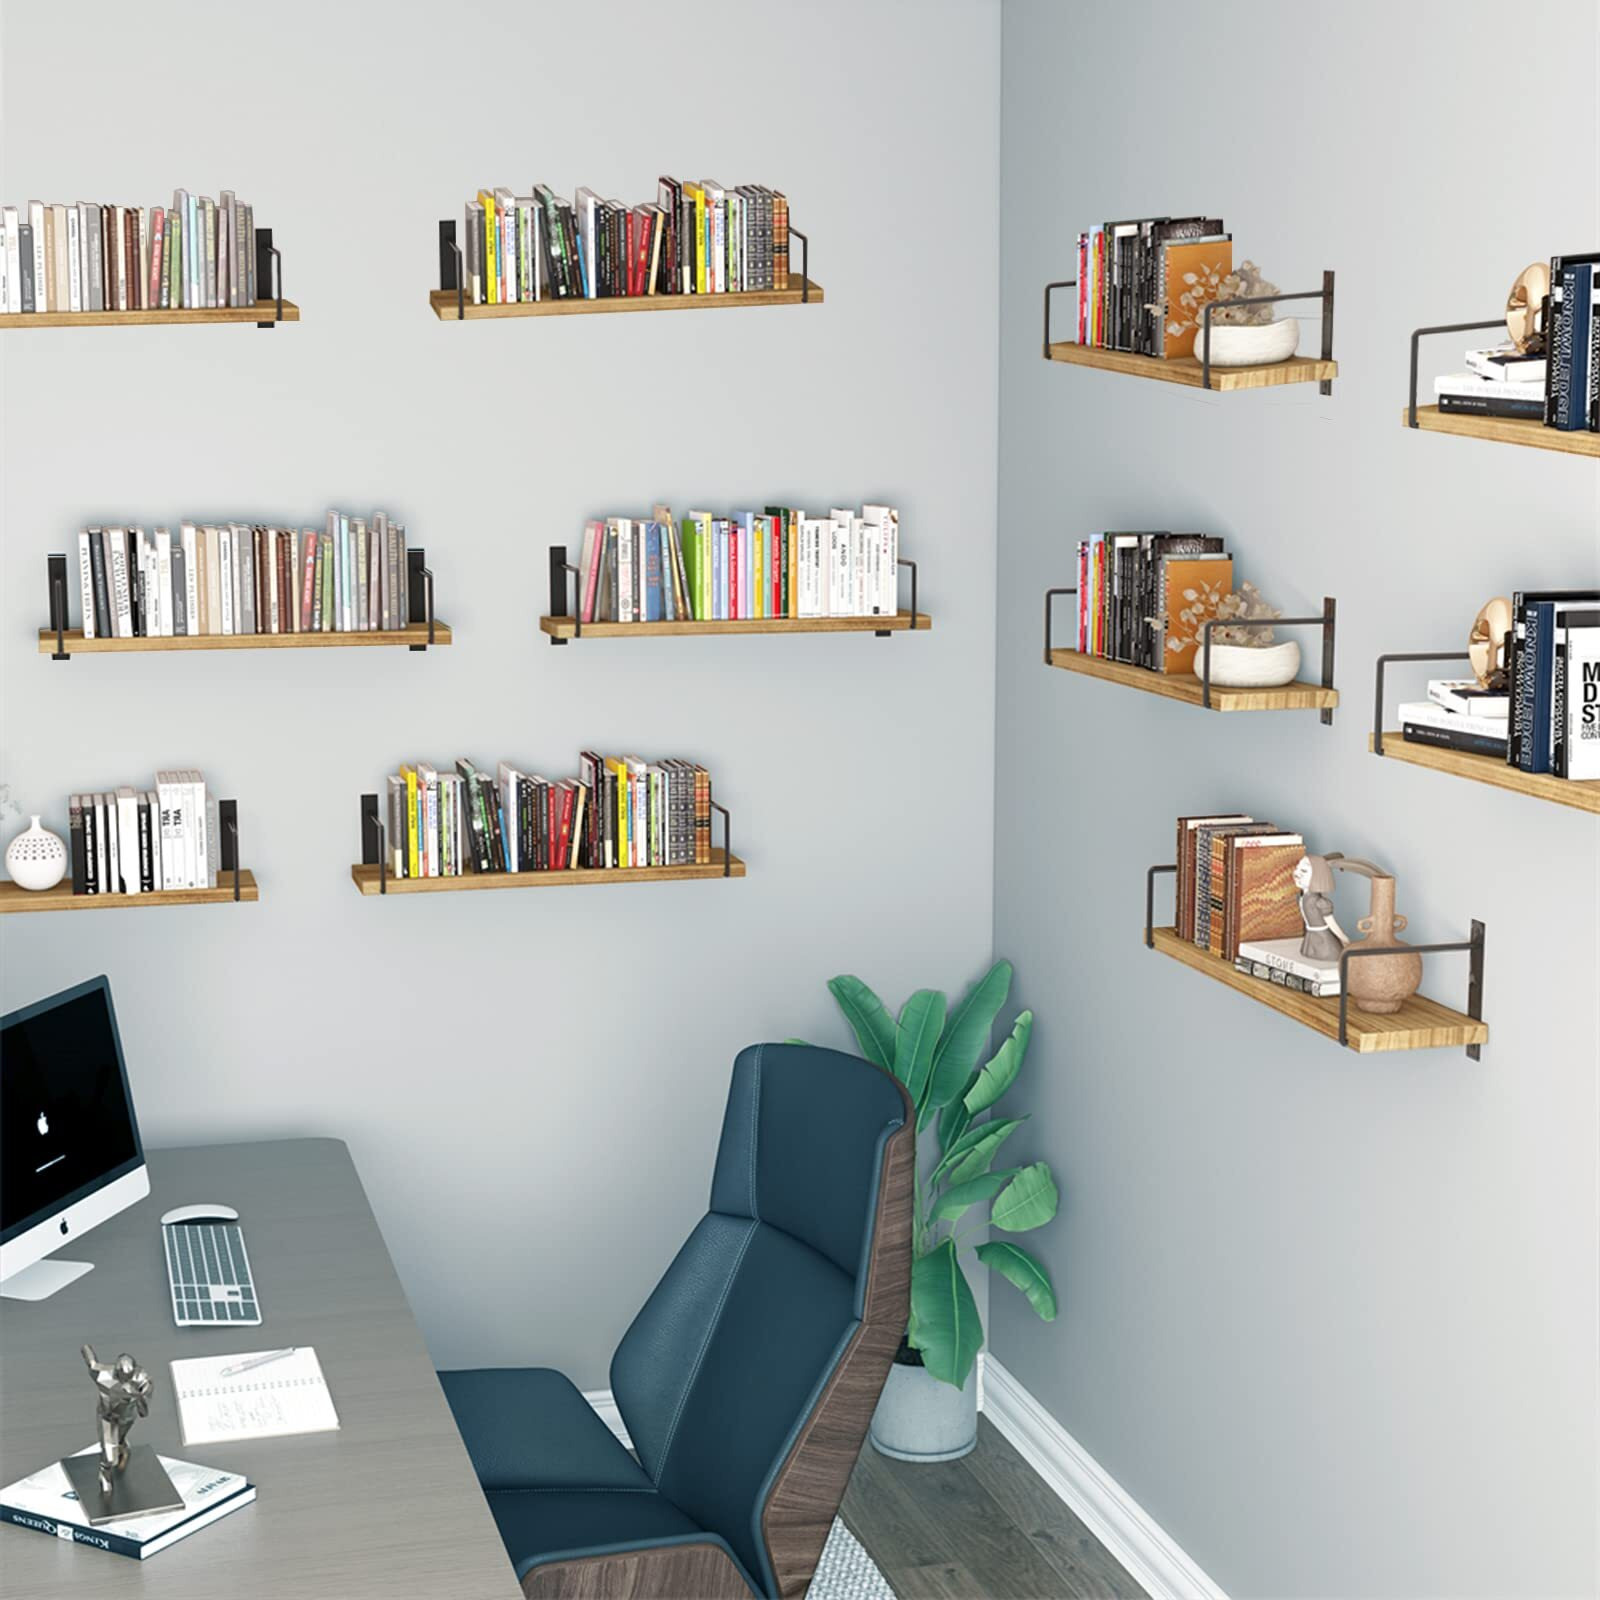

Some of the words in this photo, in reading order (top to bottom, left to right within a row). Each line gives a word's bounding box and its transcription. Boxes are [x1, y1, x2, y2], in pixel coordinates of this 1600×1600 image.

[1557, 281, 1576, 425] KNOWLEDGE
[1522, 619, 1538, 766] KNOWLEDGE
[1584, 683, 1597, 702] D
[1265, 953, 1295, 973] STONE
